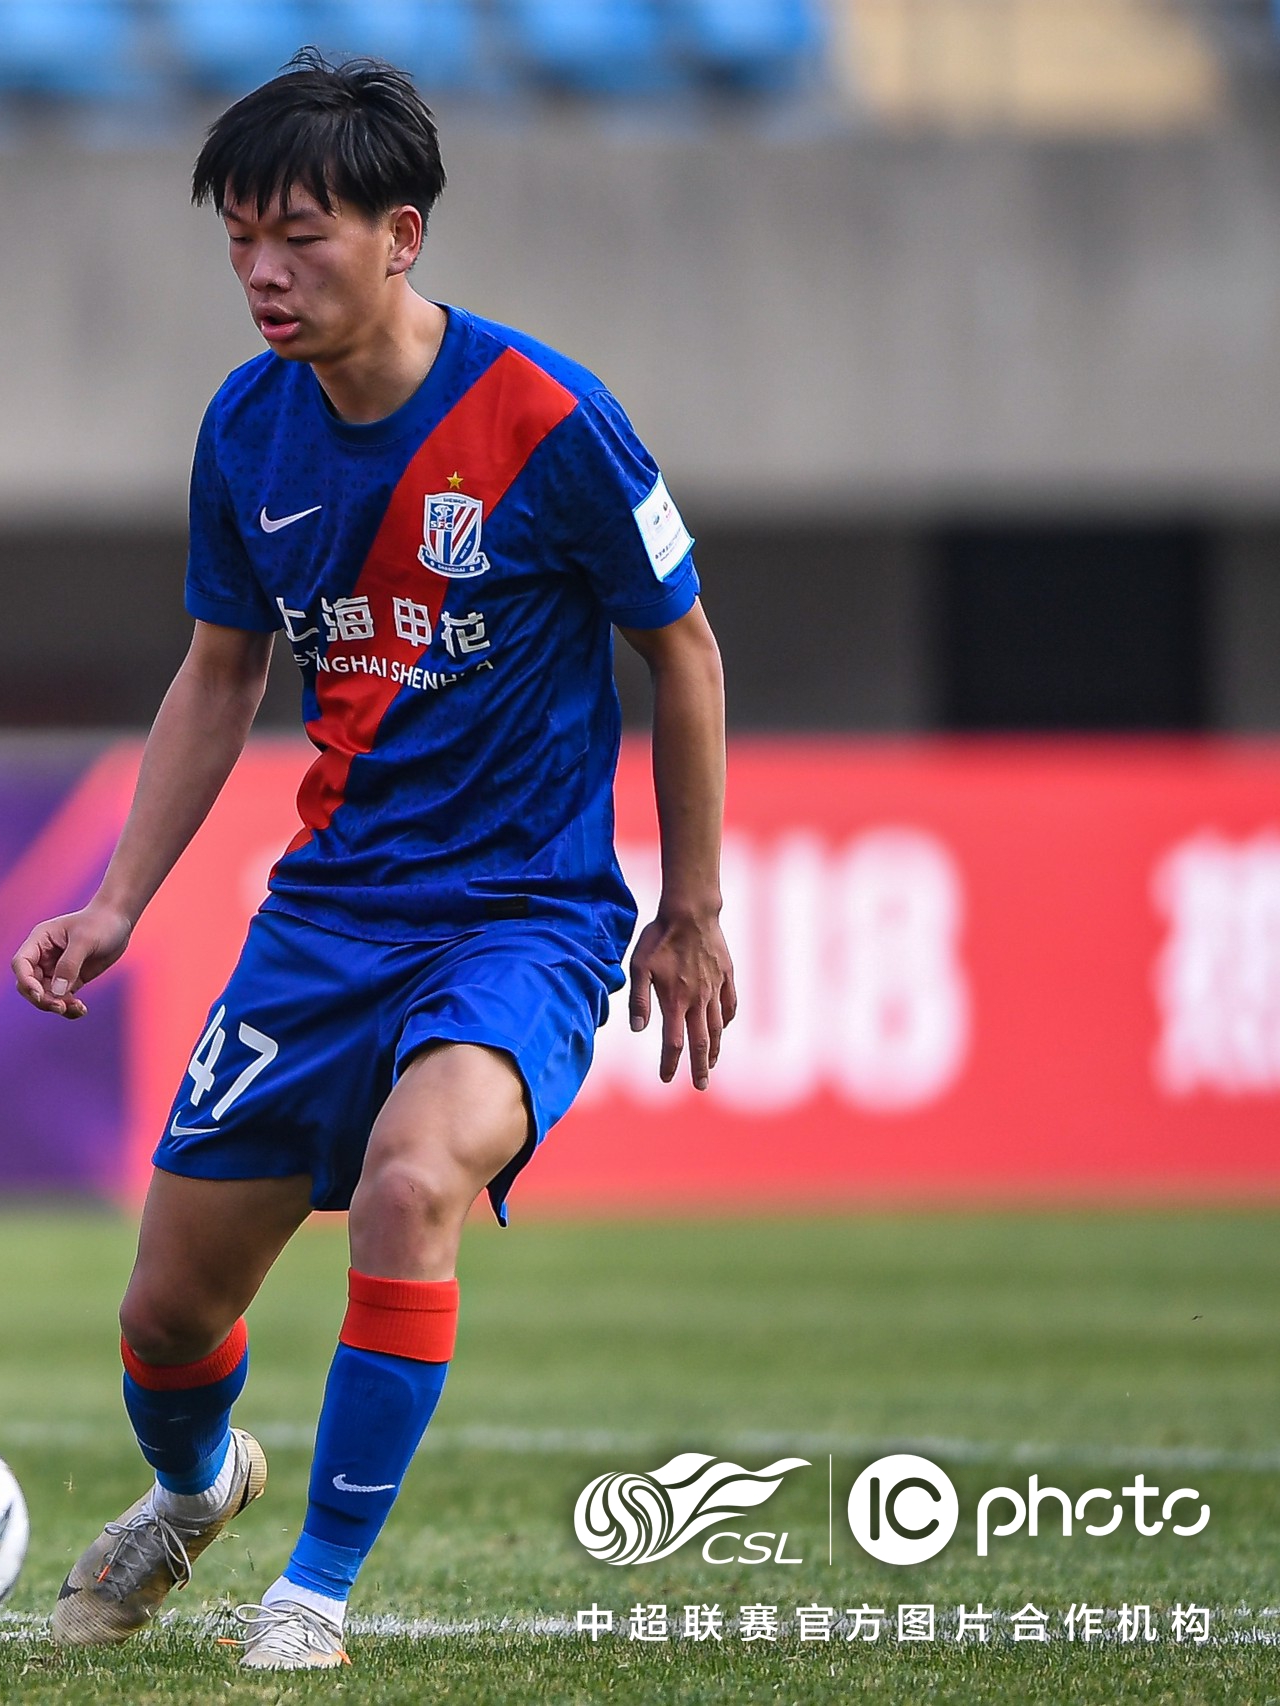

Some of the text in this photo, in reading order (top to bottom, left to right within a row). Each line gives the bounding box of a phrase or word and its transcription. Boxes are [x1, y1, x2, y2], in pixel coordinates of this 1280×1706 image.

[276, 595, 491, 658] 上海申花
[293, 646, 494, 690] SHNGHAI SHENHA
[188, 1004, 278, 1121] 47
